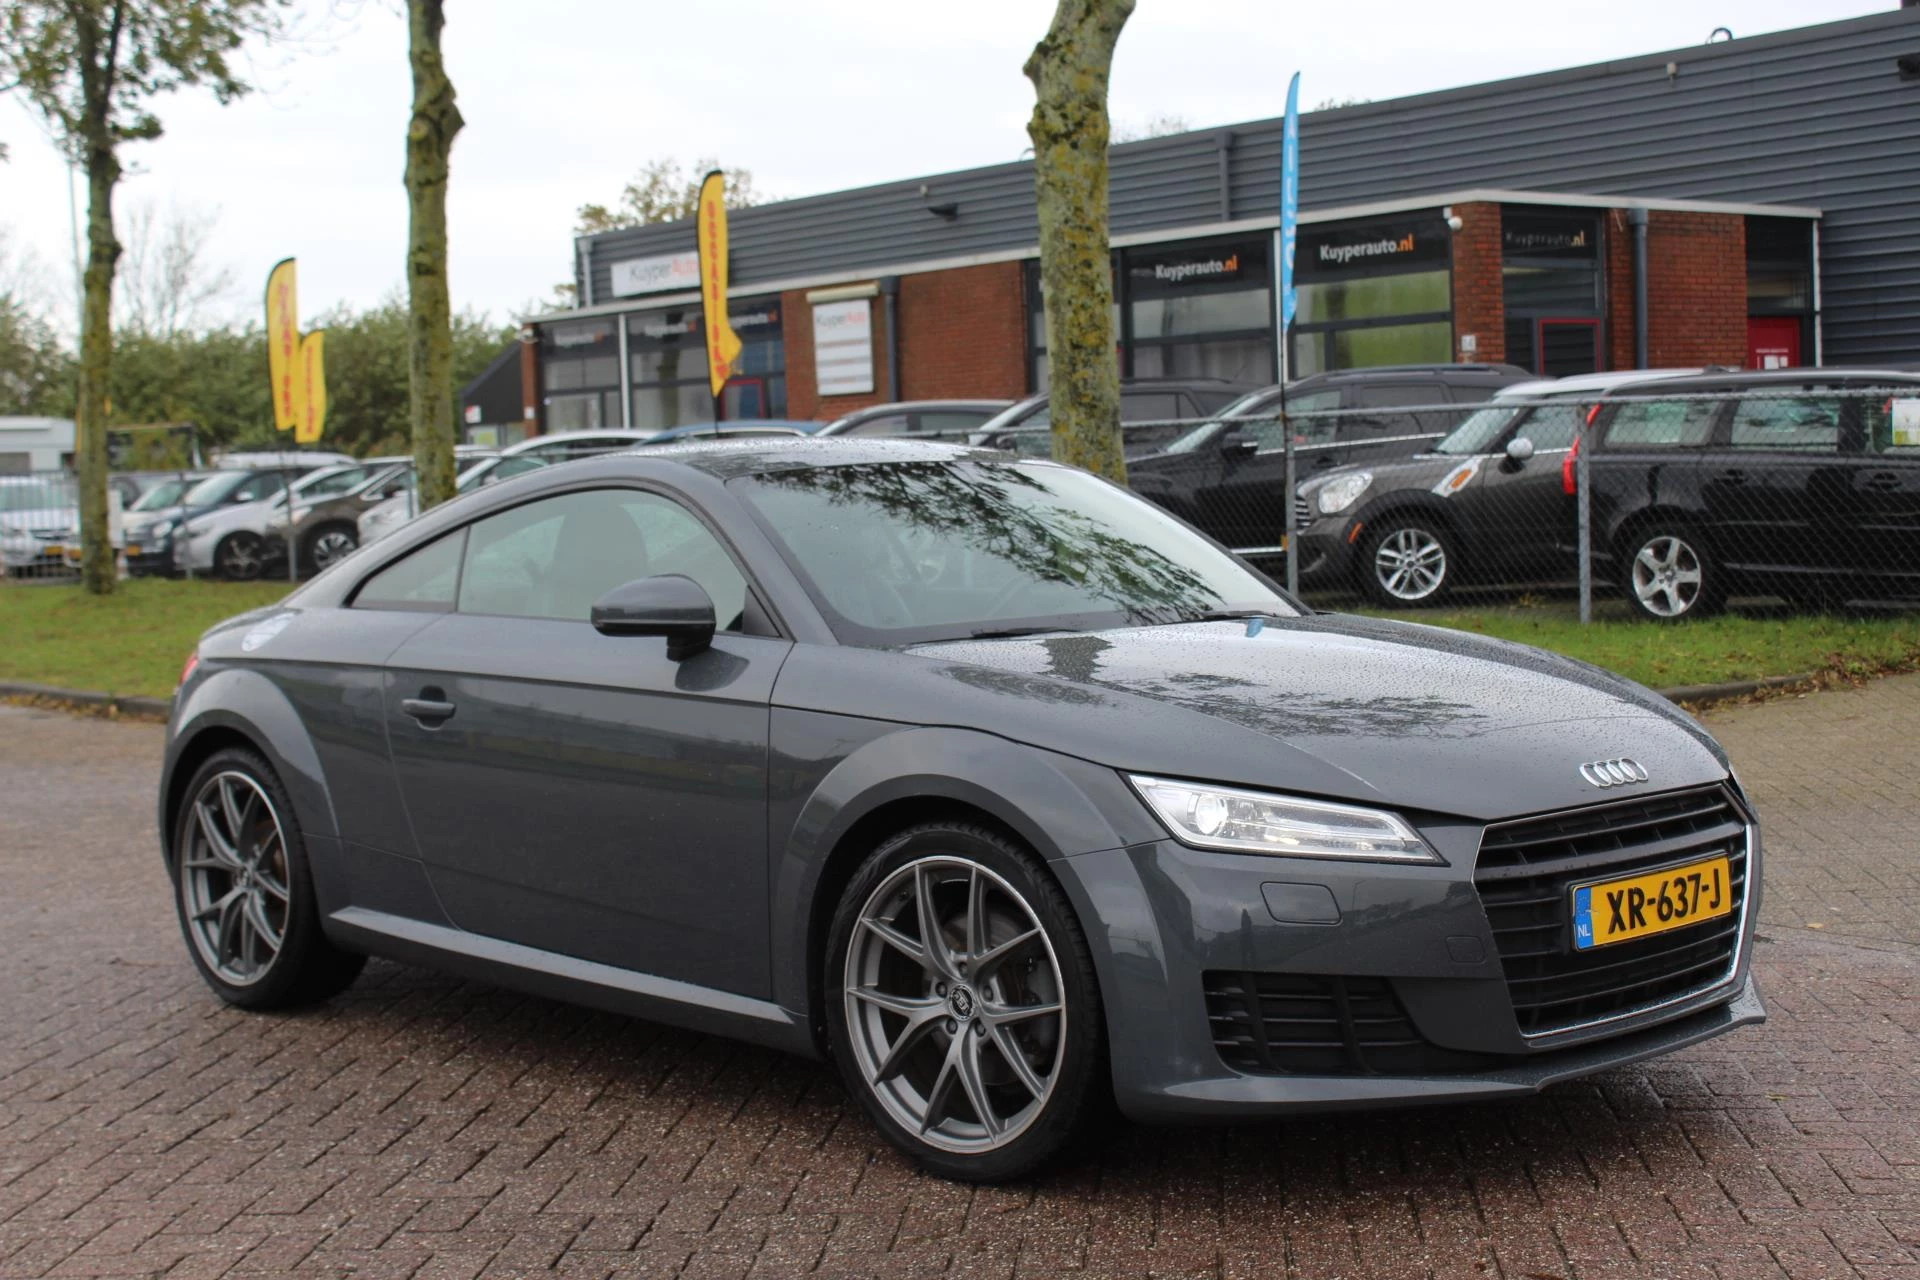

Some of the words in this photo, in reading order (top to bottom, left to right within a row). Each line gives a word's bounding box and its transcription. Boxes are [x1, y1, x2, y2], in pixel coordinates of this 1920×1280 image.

[1320, 233, 1414, 264] Kuyperauto.nl
[1155, 254, 1238, 282] Kuyperauto.nl
[1578, 924, 1591, 938] NL
[1606, 868, 1722, 935] XR-637-J
